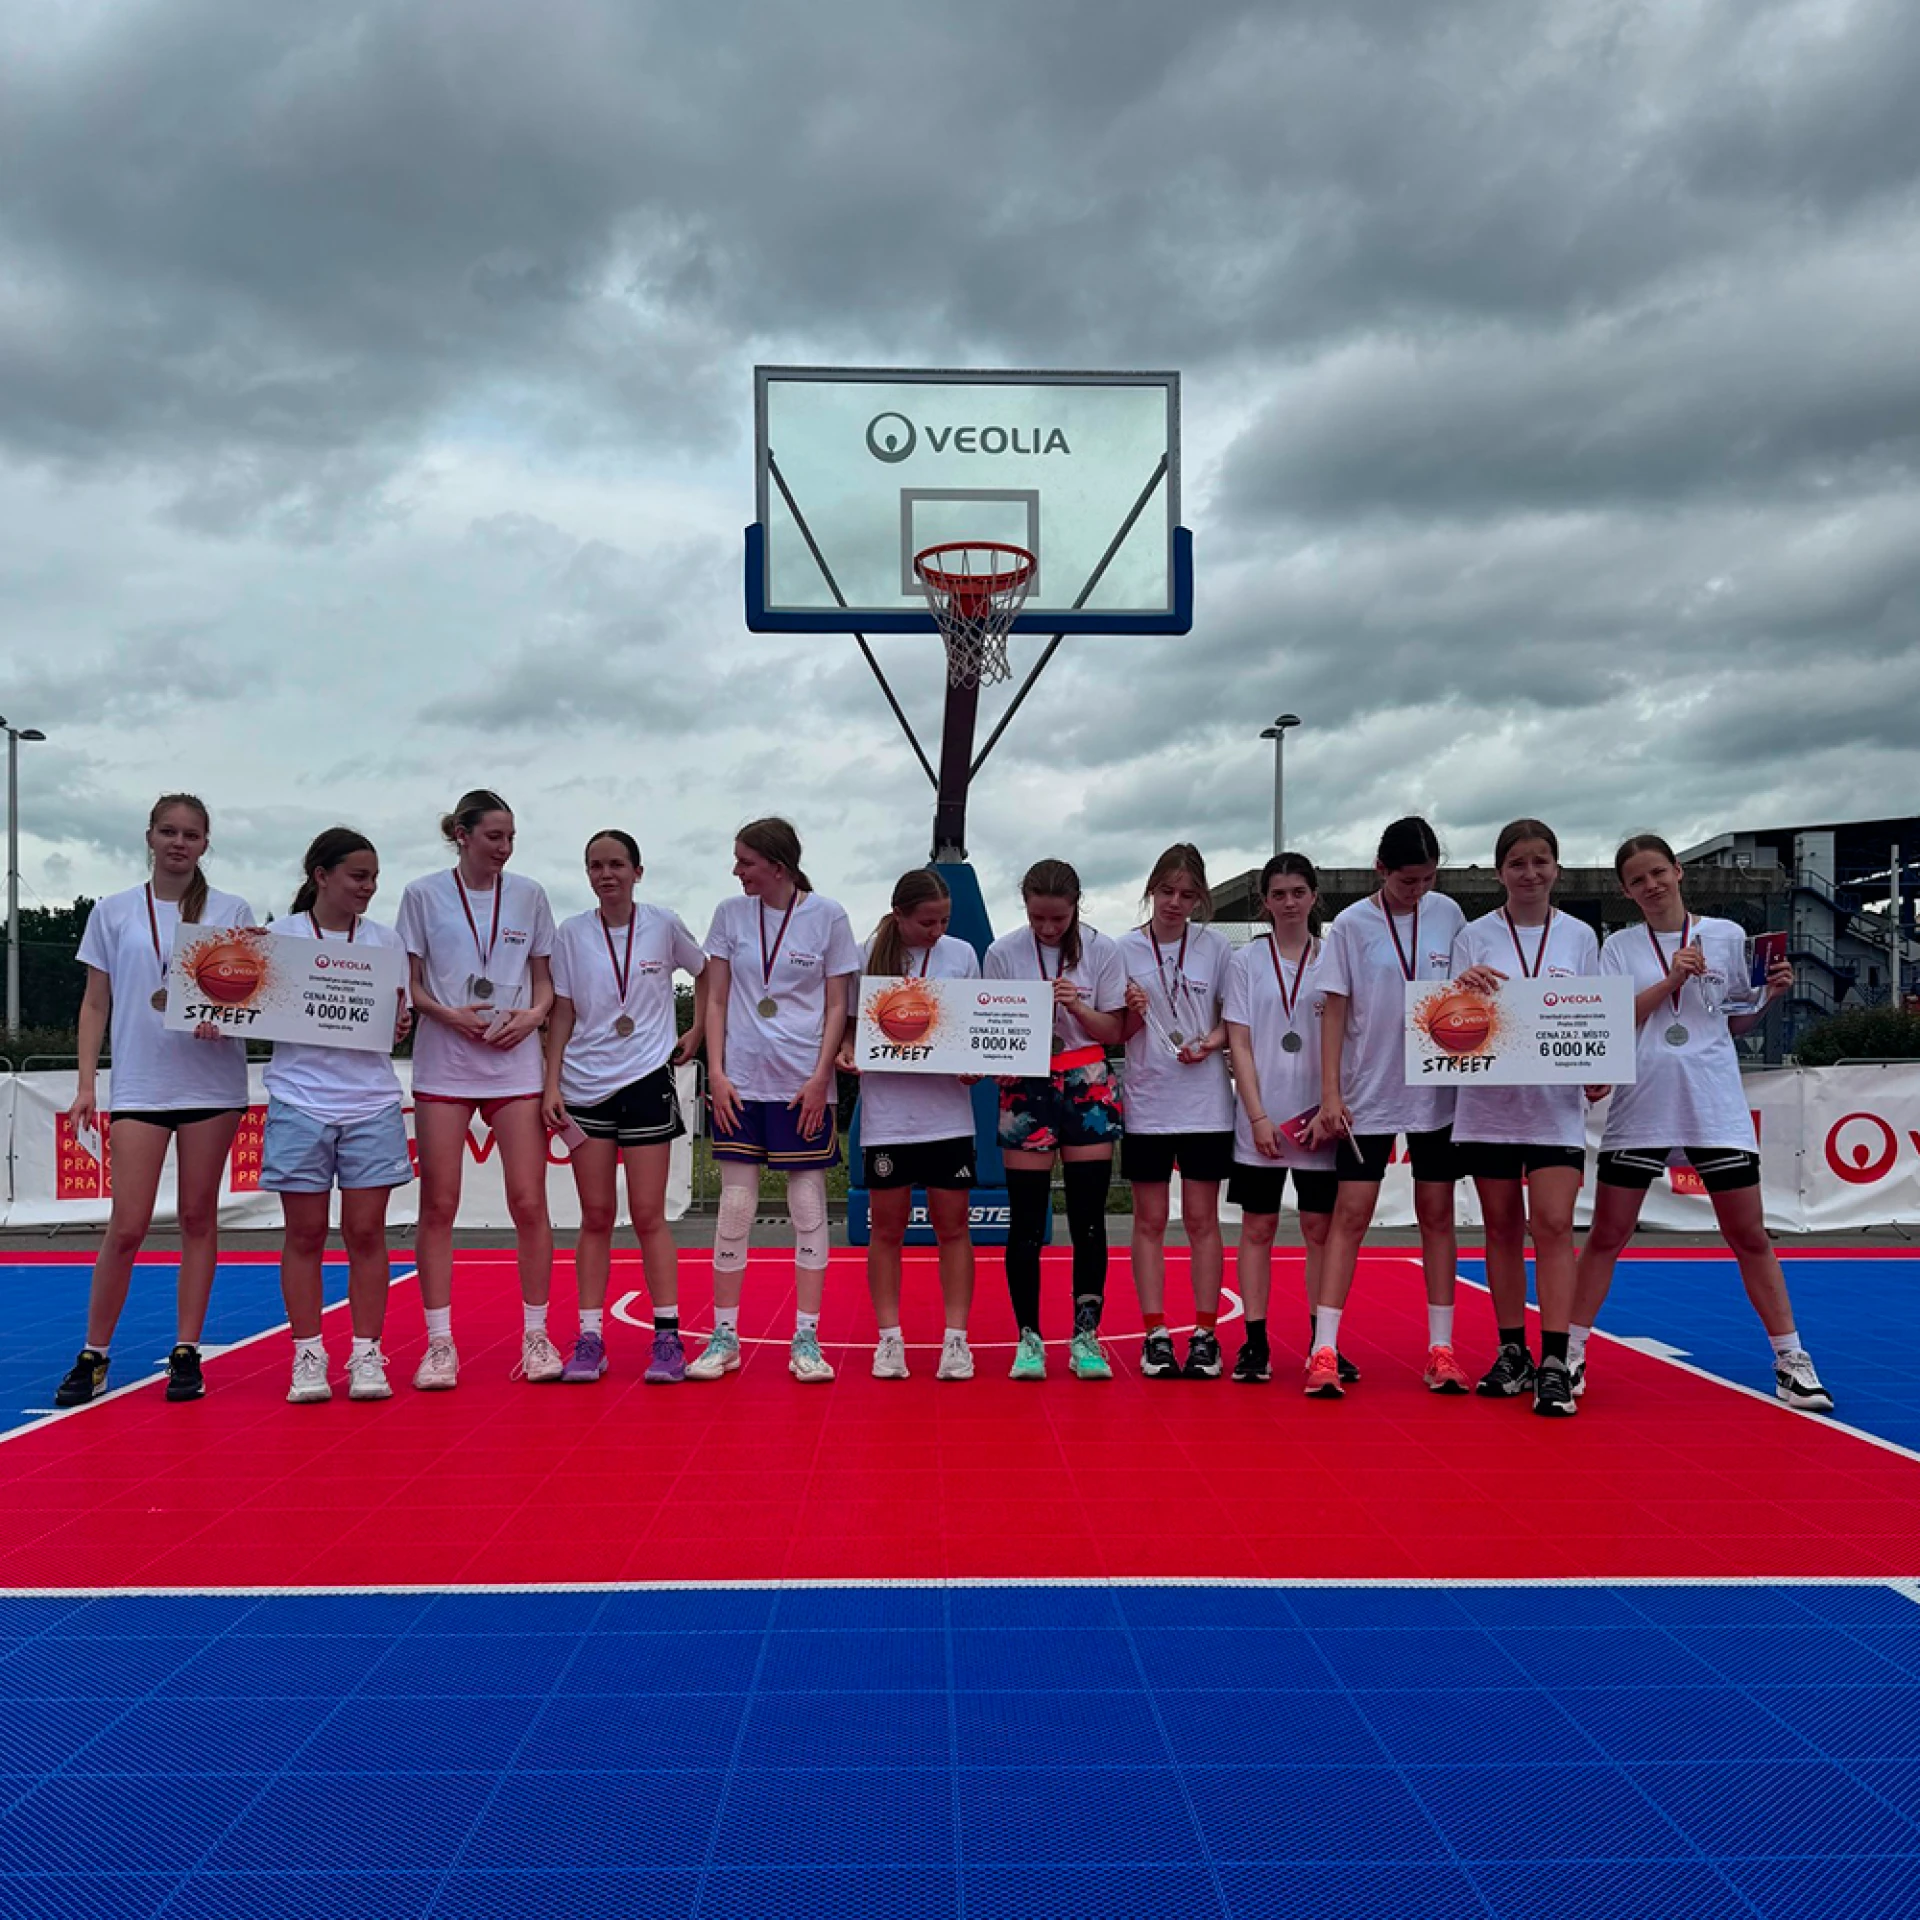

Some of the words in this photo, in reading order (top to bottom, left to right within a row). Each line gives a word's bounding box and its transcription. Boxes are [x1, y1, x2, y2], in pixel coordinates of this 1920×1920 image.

[924, 426, 1071, 455] VEOLIA
[331, 959, 372, 972] VEOLIA
[1560, 994, 1603, 1005] VEOLIA
[183, 1003, 262, 1025] STREET
[304, 1002, 316, 1017] 4
[318, 1003, 347, 1021] 000
[349, 1007, 370, 1023] Kč
[971, 1036, 980, 1049] 8
[982, 1036, 1007, 1051] 000
[1009, 1037, 1028, 1051] Kč
[1535, 1030, 1560, 1040] CENA
[869, 1044, 934, 1061] STREET
[1540, 1041, 1550, 1057] 6
[1552, 1041, 1583, 1057] 000
[1585, 1040, 1606, 1057] Kč
[1422, 1055, 1497, 1074] STREET
[1677, 1173, 1704, 1187] PR
